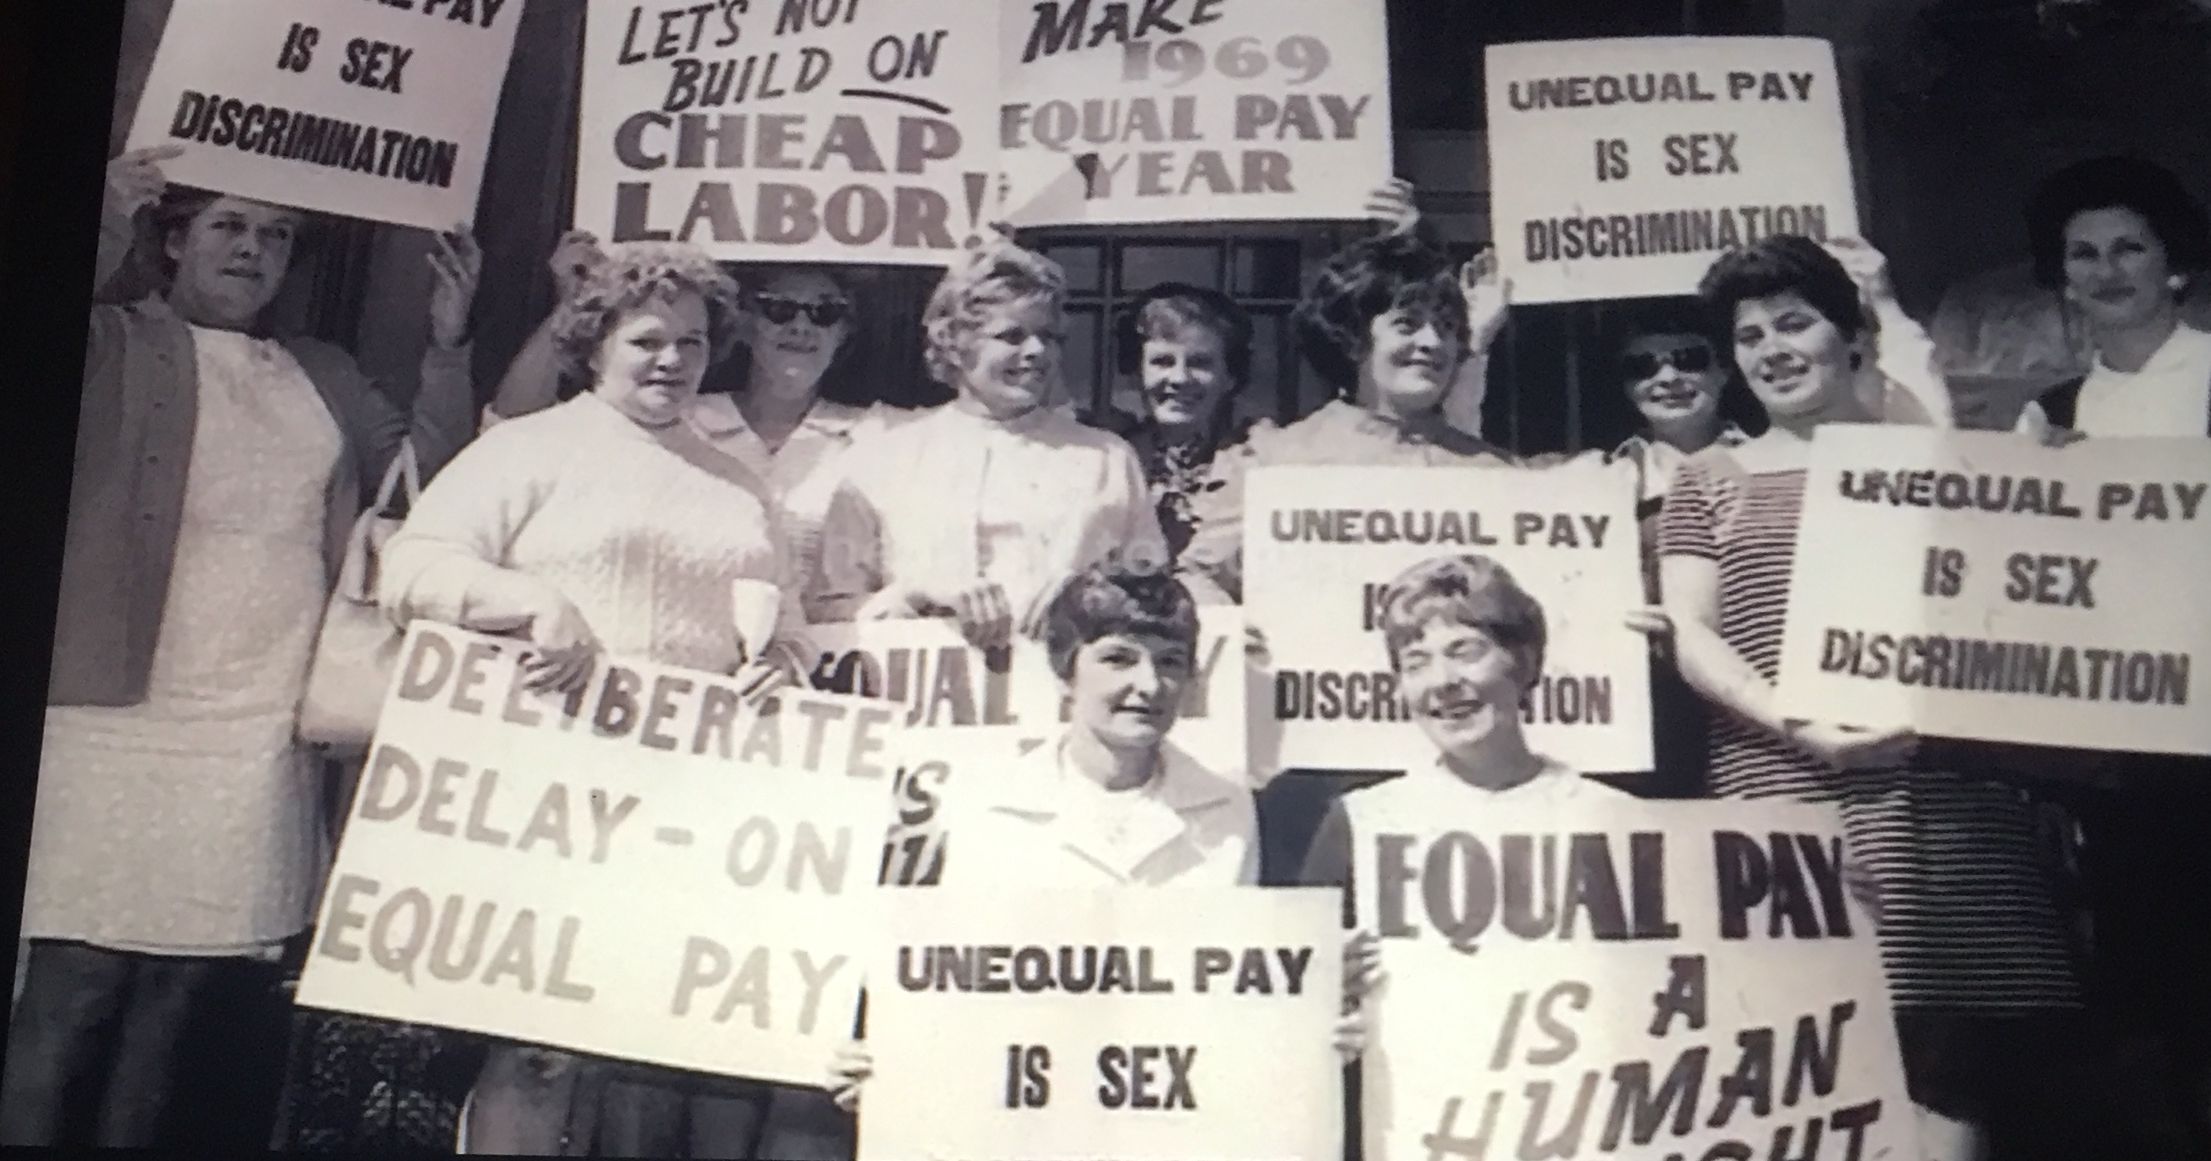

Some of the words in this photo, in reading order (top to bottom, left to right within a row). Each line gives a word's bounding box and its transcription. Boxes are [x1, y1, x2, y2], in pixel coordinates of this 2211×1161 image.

[277, 22, 319, 73] IS
[340, 37, 414, 94] SEX
[618, 0, 749, 65] LET'S
[1122, 35, 1330, 89] 1969
[662, 48, 832, 112] BUILD
[868, 29, 949, 83] ON
[1508, 71, 1716, 111] UNEQUAL
[1726, 71, 1815, 102] PAY
[169, 89, 459, 189] DISCRIMINATION
[614, 111, 962, 173] CHEAP
[1000, 95, 1204, 152] EQUAL
[1234, 93, 1372, 142] PAY
[1073, 149, 1295, 201] YEAR
[1595, 138, 1629, 182] IS
[1663, 132, 1740, 177] SEX
[612, 171, 988, 250] LABOR!
[1524, 204, 1827, 262] DISCRIMINATION
[1839, 469, 2082, 519] UNEQUAL
[2097, 482, 2208, 521] PAY
[1270, 509, 1498, 546] UNEQUAL
[1513, 511, 1611, 548] PAY
[1920, 545, 1966, 598] IS
[2004, 551, 2099, 609] SEX
[810, 646, 1018, 728] QUAL
[1820, 626, 2192, 706] DISCRIMINATION
[399, 630, 892, 779] DELIBERATE
[360, 744, 640, 864] DELAY
[725, 815, 854, 896] ON
[1376, 829, 1681, 955] EQUAL
[1712, 829, 1853, 939] PAY
[318, 872, 596, 1003] EQUAL
[670, 935, 849, 1035] PAY
[899, 945, 1174, 994] UNEQUAL
[1193, 946, 1313, 995] PAY
[1489, 981, 1592, 1071] IS
[1649, 954, 1706, 1037] A
[1006, 1044, 1052, 1109] IS
[1097, 1045, 1198, 1110] SEX
[1421, 999, 1856, 1161] HUMAN
